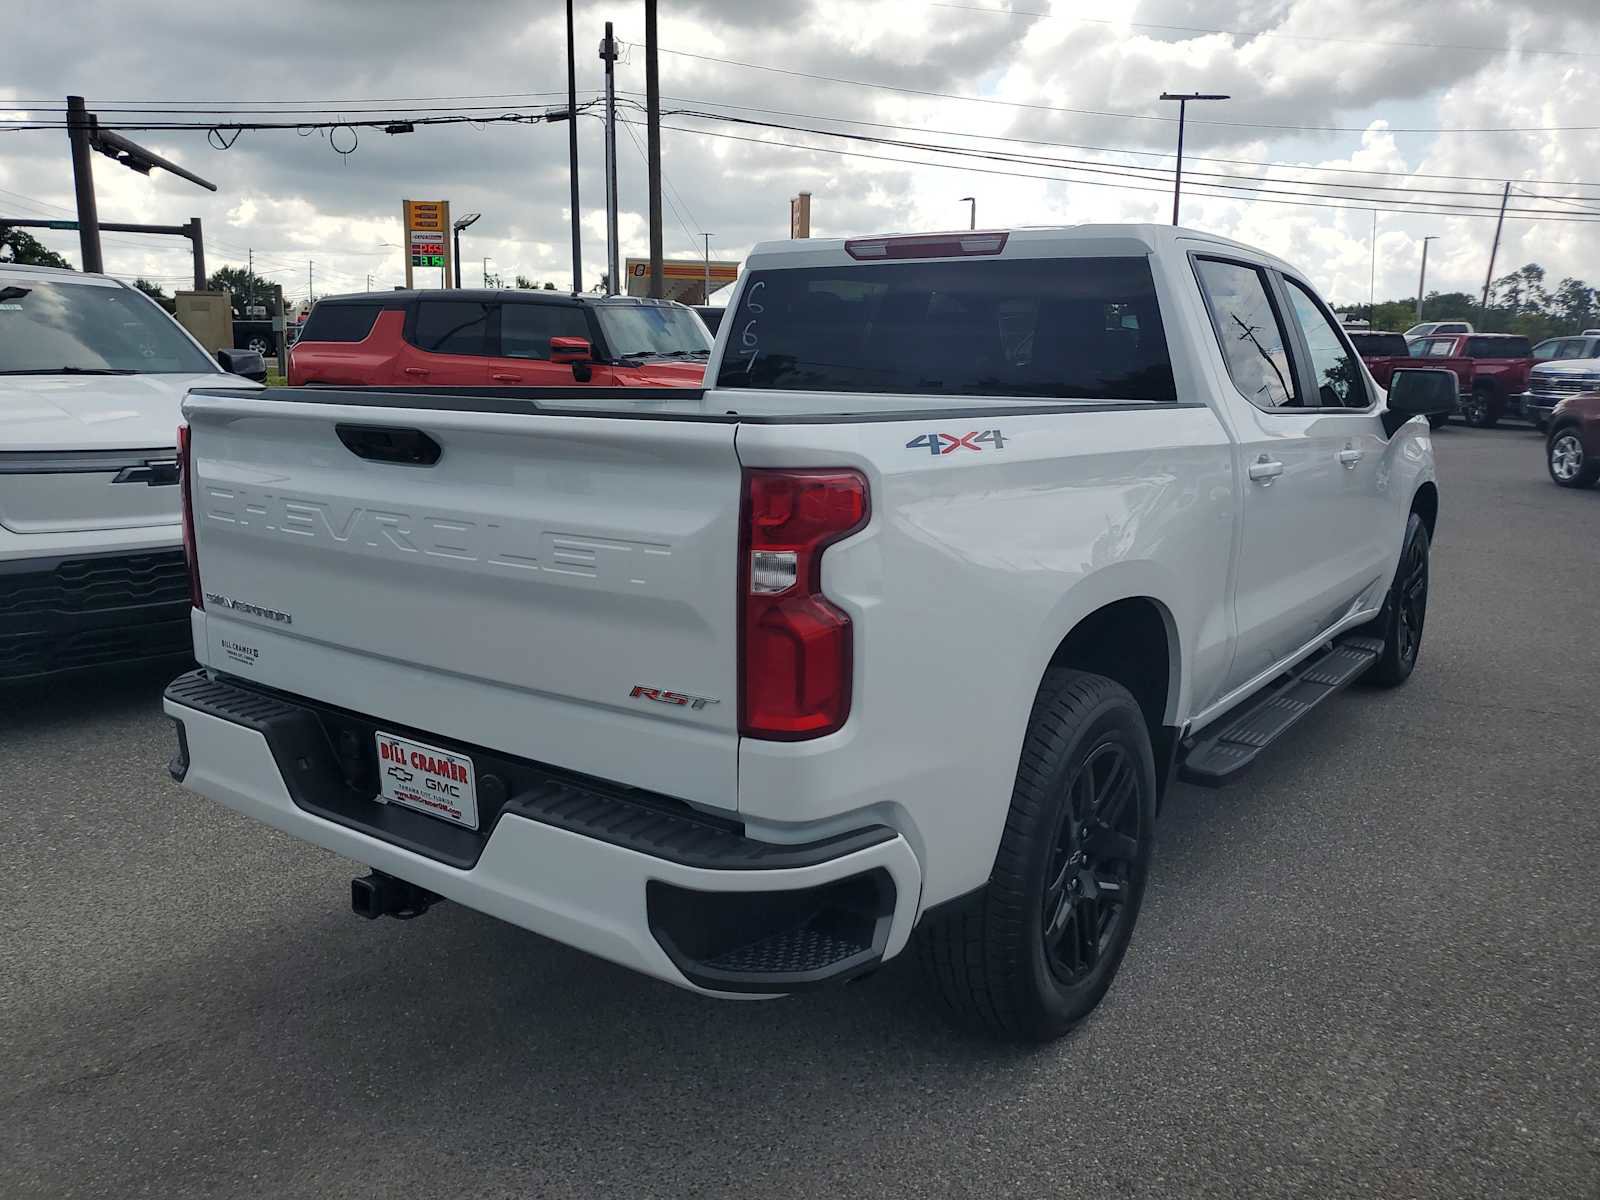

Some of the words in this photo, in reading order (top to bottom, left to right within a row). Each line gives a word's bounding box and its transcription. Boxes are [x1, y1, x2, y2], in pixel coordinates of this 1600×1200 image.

[205, 486, 672, 586] CHEVROLET
[629, 685, 720, 710] RST
[380, 742, 407, 765] BILL
[410, 751, 468, 785] CRAMER
[425, 777, 460, 798] GMC
